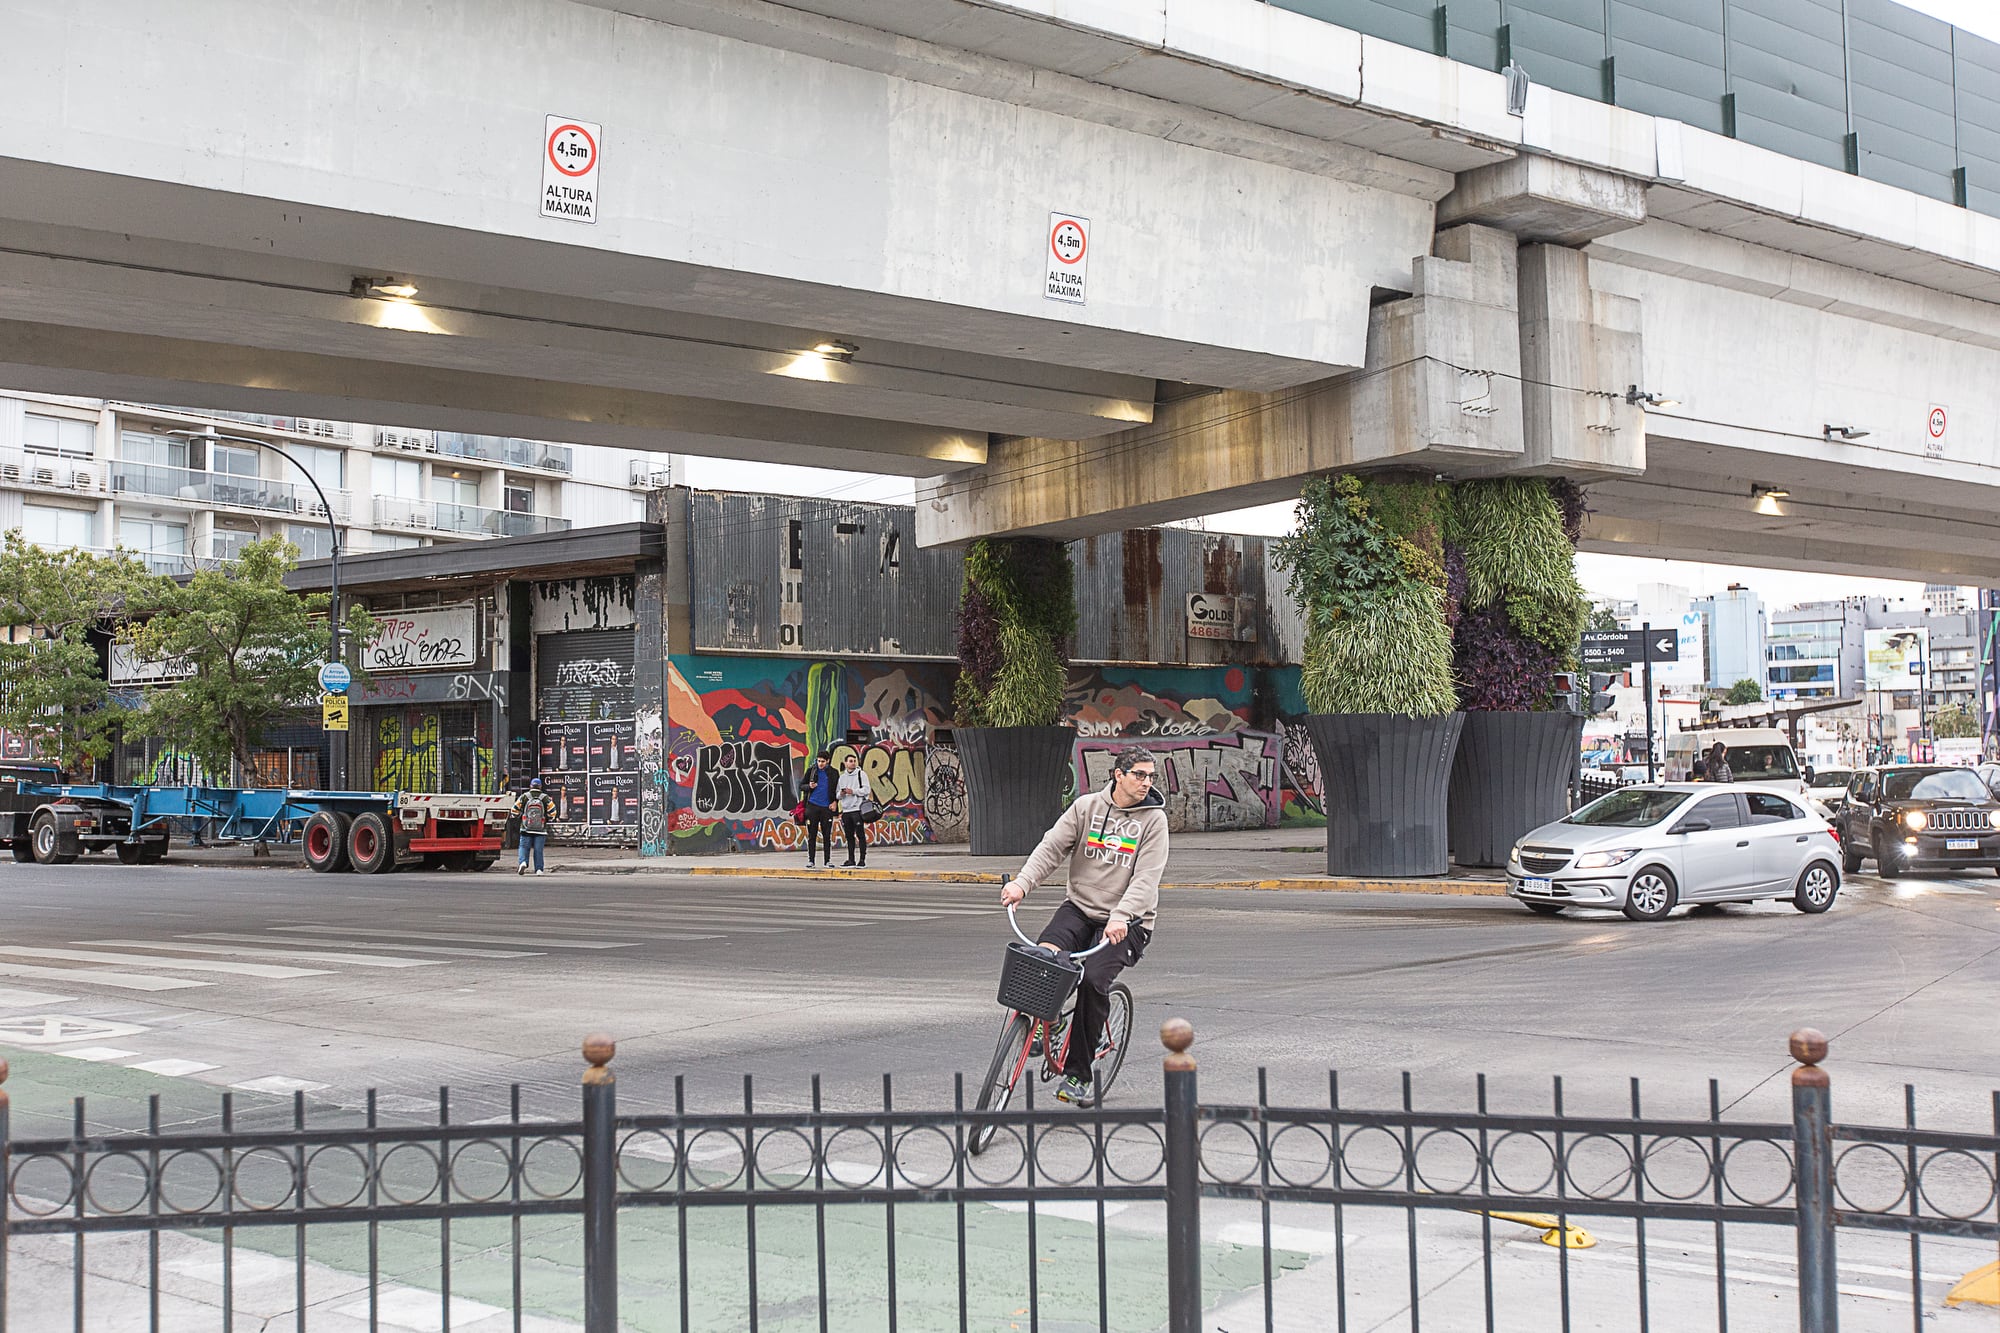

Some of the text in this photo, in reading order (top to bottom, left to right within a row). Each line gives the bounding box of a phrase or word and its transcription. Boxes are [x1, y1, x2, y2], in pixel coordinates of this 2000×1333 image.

[557, 141, 588, 158] 4,5m
[546, 184, 593, 203] ALTURA
[545, 198, 592, 218] MÁXIMA
[1057, 234, 1080, 248] 4,5m
[1049, 271, 1083, 286] ALTURA
[1048, 283, 1082, 298] MÁXIMA
[1596, 633, 1629, 641] Córdoba
[1584, 648, 1601, 656] 5500
[1607, 648, 1625, 656] 5400
[399, 796, 409, 805] 80
